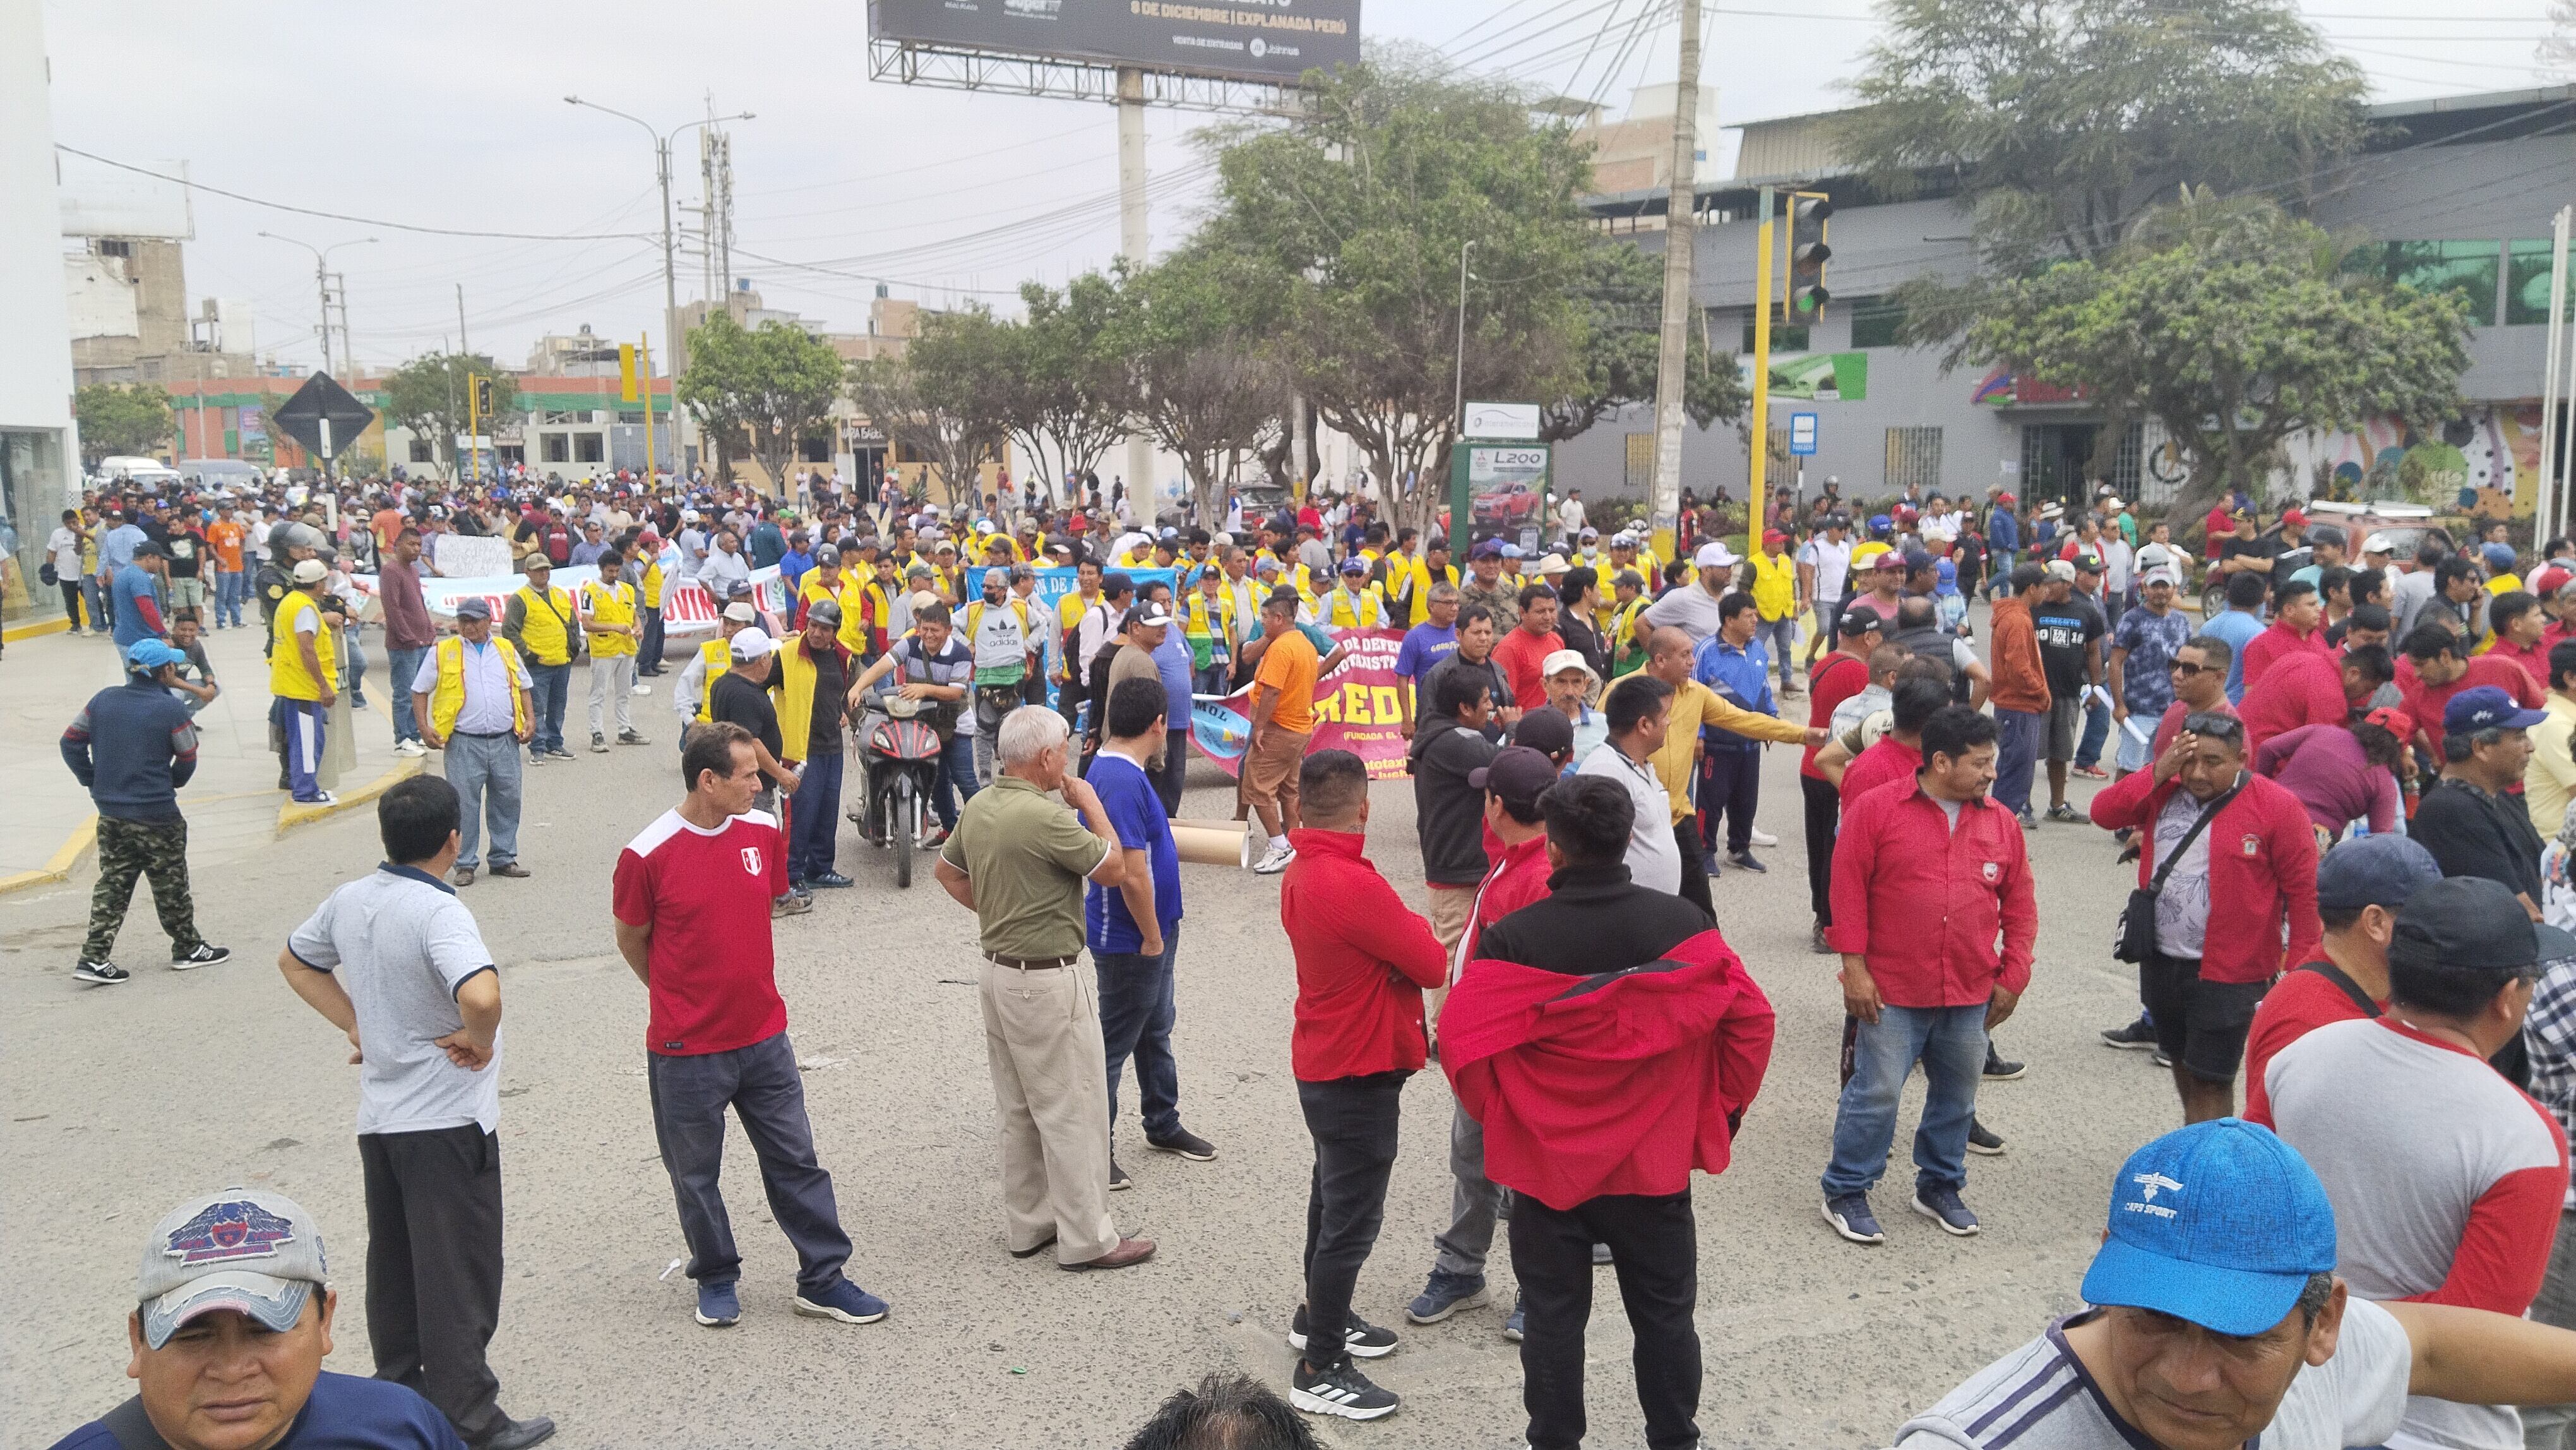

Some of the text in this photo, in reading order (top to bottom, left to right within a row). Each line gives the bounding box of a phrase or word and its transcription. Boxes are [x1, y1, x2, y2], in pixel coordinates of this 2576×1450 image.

[1131, 1, 1140, 14] 8
[1142, 3, 1160, 16] DE
[1162, 4, 1229, 24] DICIEMBRE
[1237, 11, 1313, 32] EXPLANADA
[1315, 19, 1347, 34] PERÚ
[1172, 35, 1195, 46] VENTA
[1494, 451, 1541, 464] L200
[1051, 576, 1068, 594] DE
[989, 638, 1018, 647] adidas
[1342, 636, 1403, 655] DE DEFEN
[1194, 700, 1228, 722] MOL
[1343, 731, 1383, 742] (FUNDADA
[2124, 1202, 2178, 1219] CAPS SPORT
[253, 1231, 283, 1241] YORK
